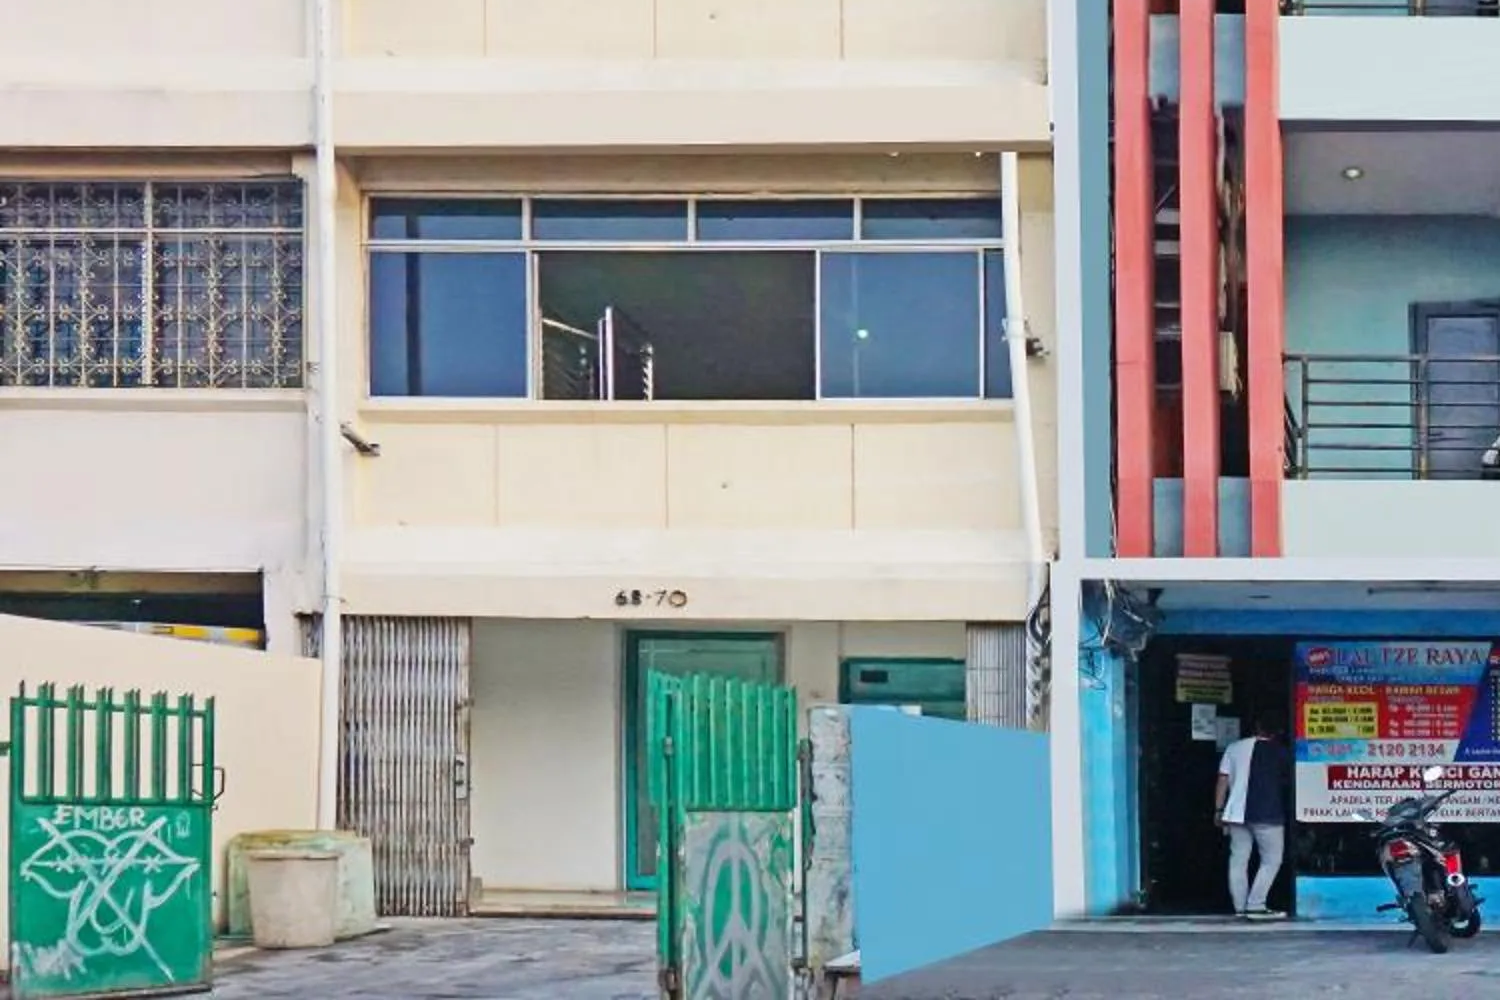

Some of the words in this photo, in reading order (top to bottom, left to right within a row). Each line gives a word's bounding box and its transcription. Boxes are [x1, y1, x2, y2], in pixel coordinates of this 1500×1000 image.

[615, 589, 688, 608] 68-70
[1426, 647, 1485, 665] RAYA
[1367, 743, 1405, 758] 2120
[1409, 743, 1446, 758] 2134
[1347, 766, 1405, 779] HARAP
[1409, 766, 1463, 779] KCI
[1333, 780, 1421, 789] KENDARAAN
[53, 805, 147, 831] EMBER
